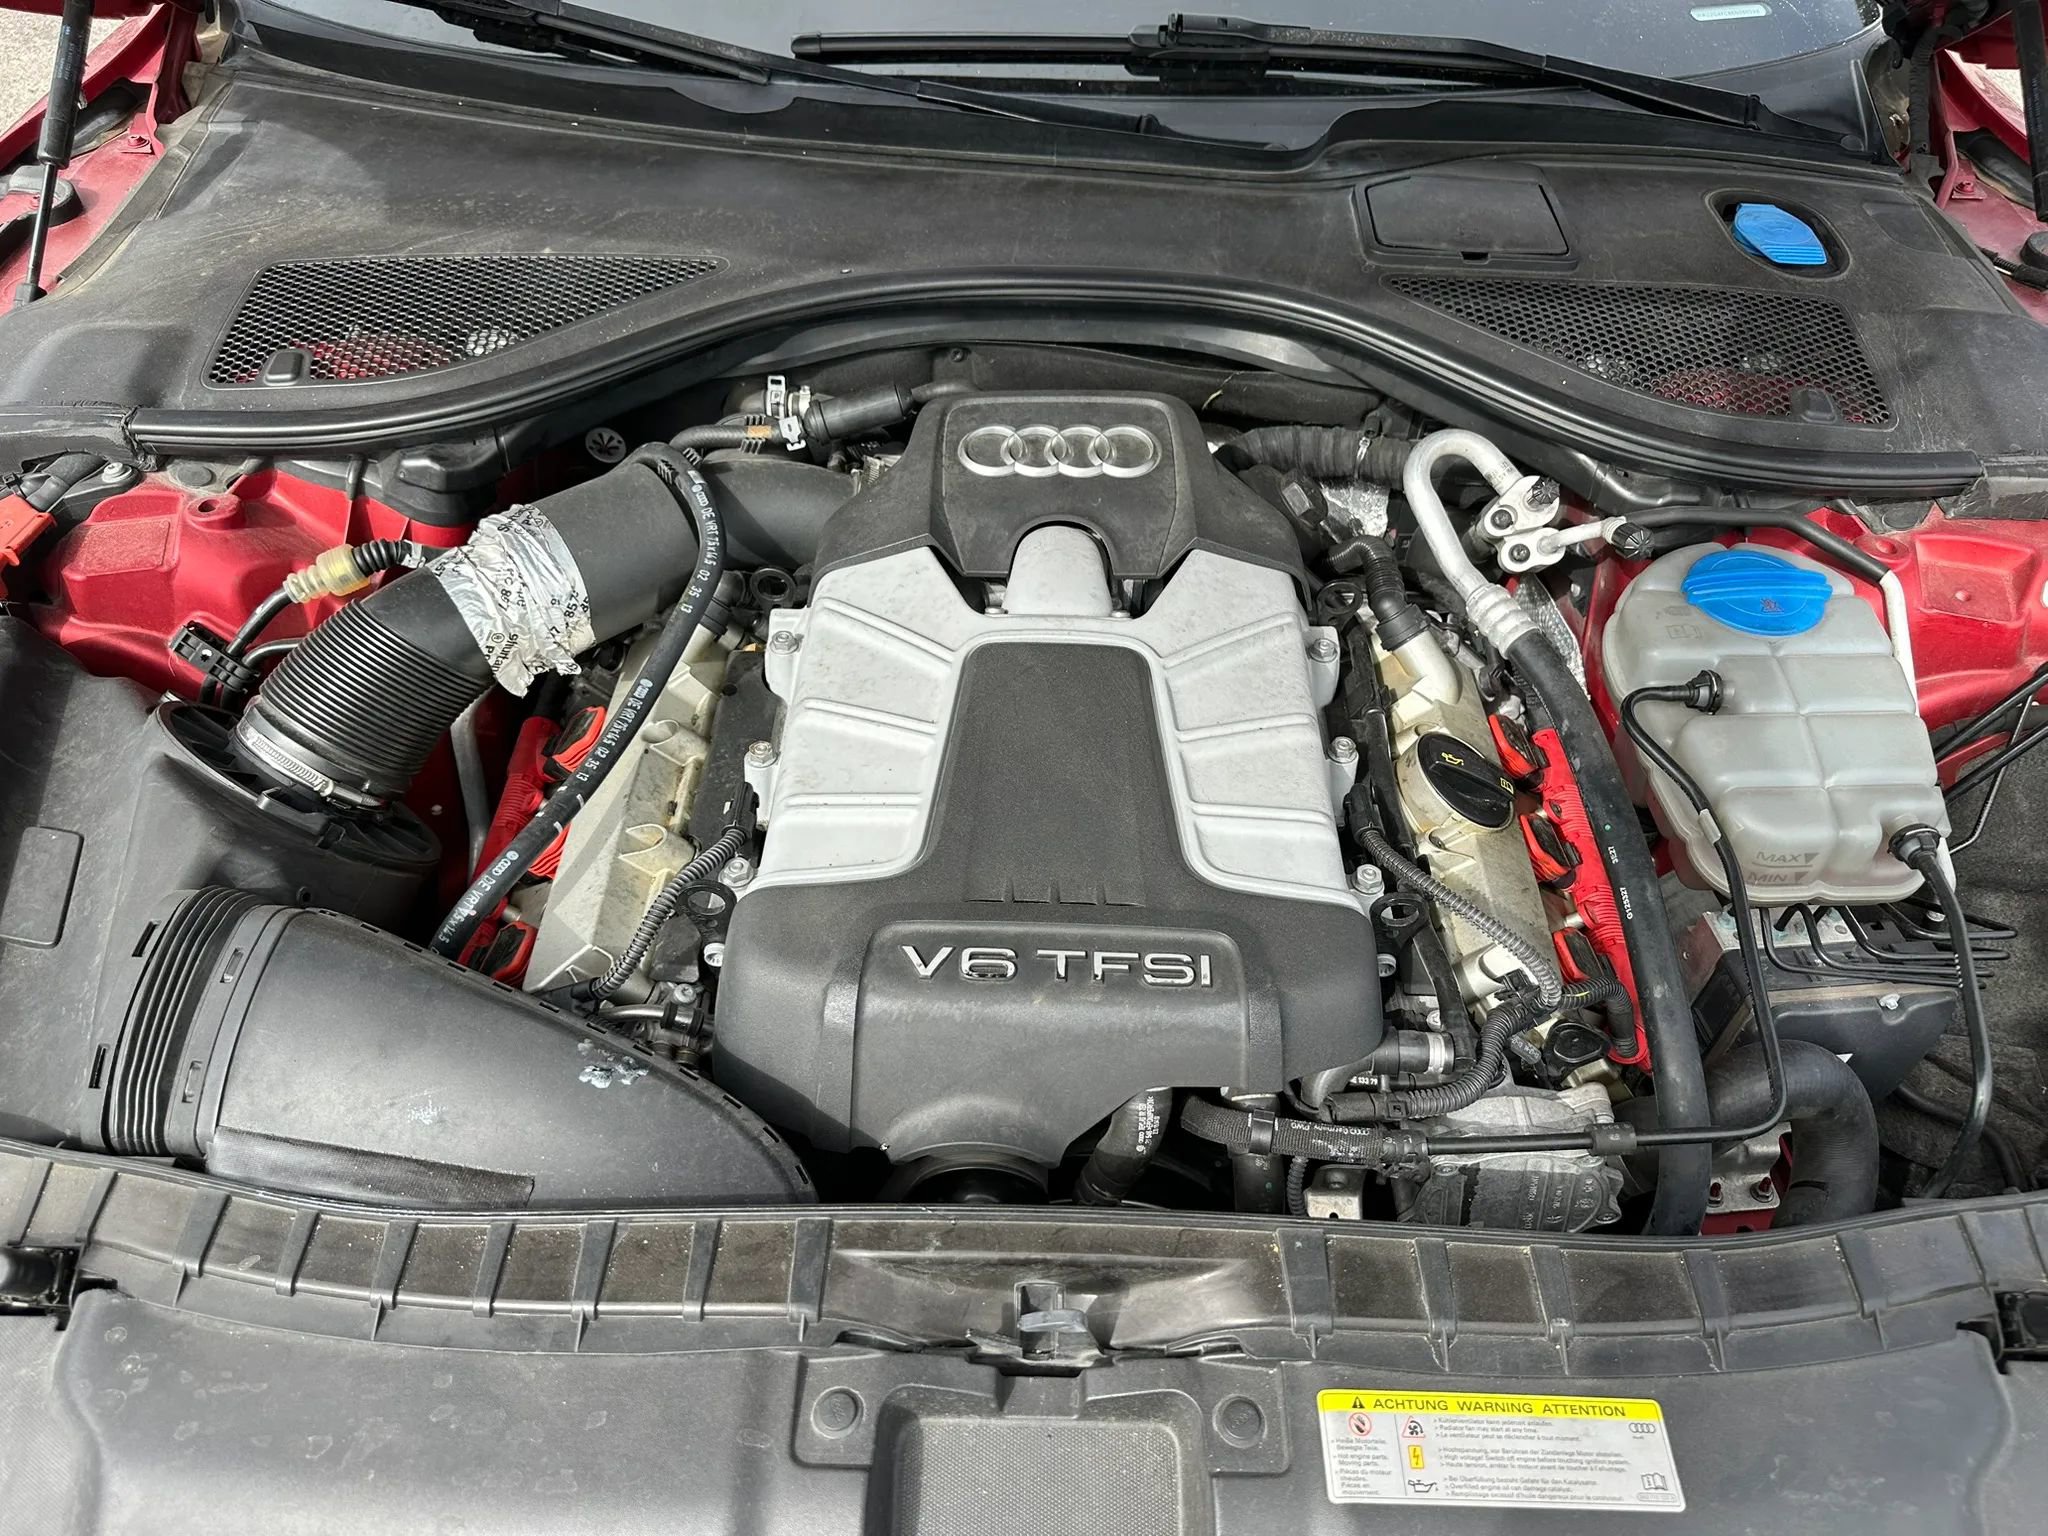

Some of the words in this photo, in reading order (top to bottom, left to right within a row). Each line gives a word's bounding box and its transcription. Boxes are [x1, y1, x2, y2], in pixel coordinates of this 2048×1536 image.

[696, 569, 711, 581] 02
[688, 585, 703, 599] 35
[680, 602, 694, 614] 13
[1756, 851, 1802, 863] MAX
[1747, 871, 1788, 883] MIN
[901, 945, 1018, 982] V6
[1036, 948, 1213, 989] TFSI
[1373, 1398, 1449, 1411] ACHTUNG
[1457, 1400, 1533, 1413] WARNING
[1542, 1403, 1626, 1417] ATTENTION
